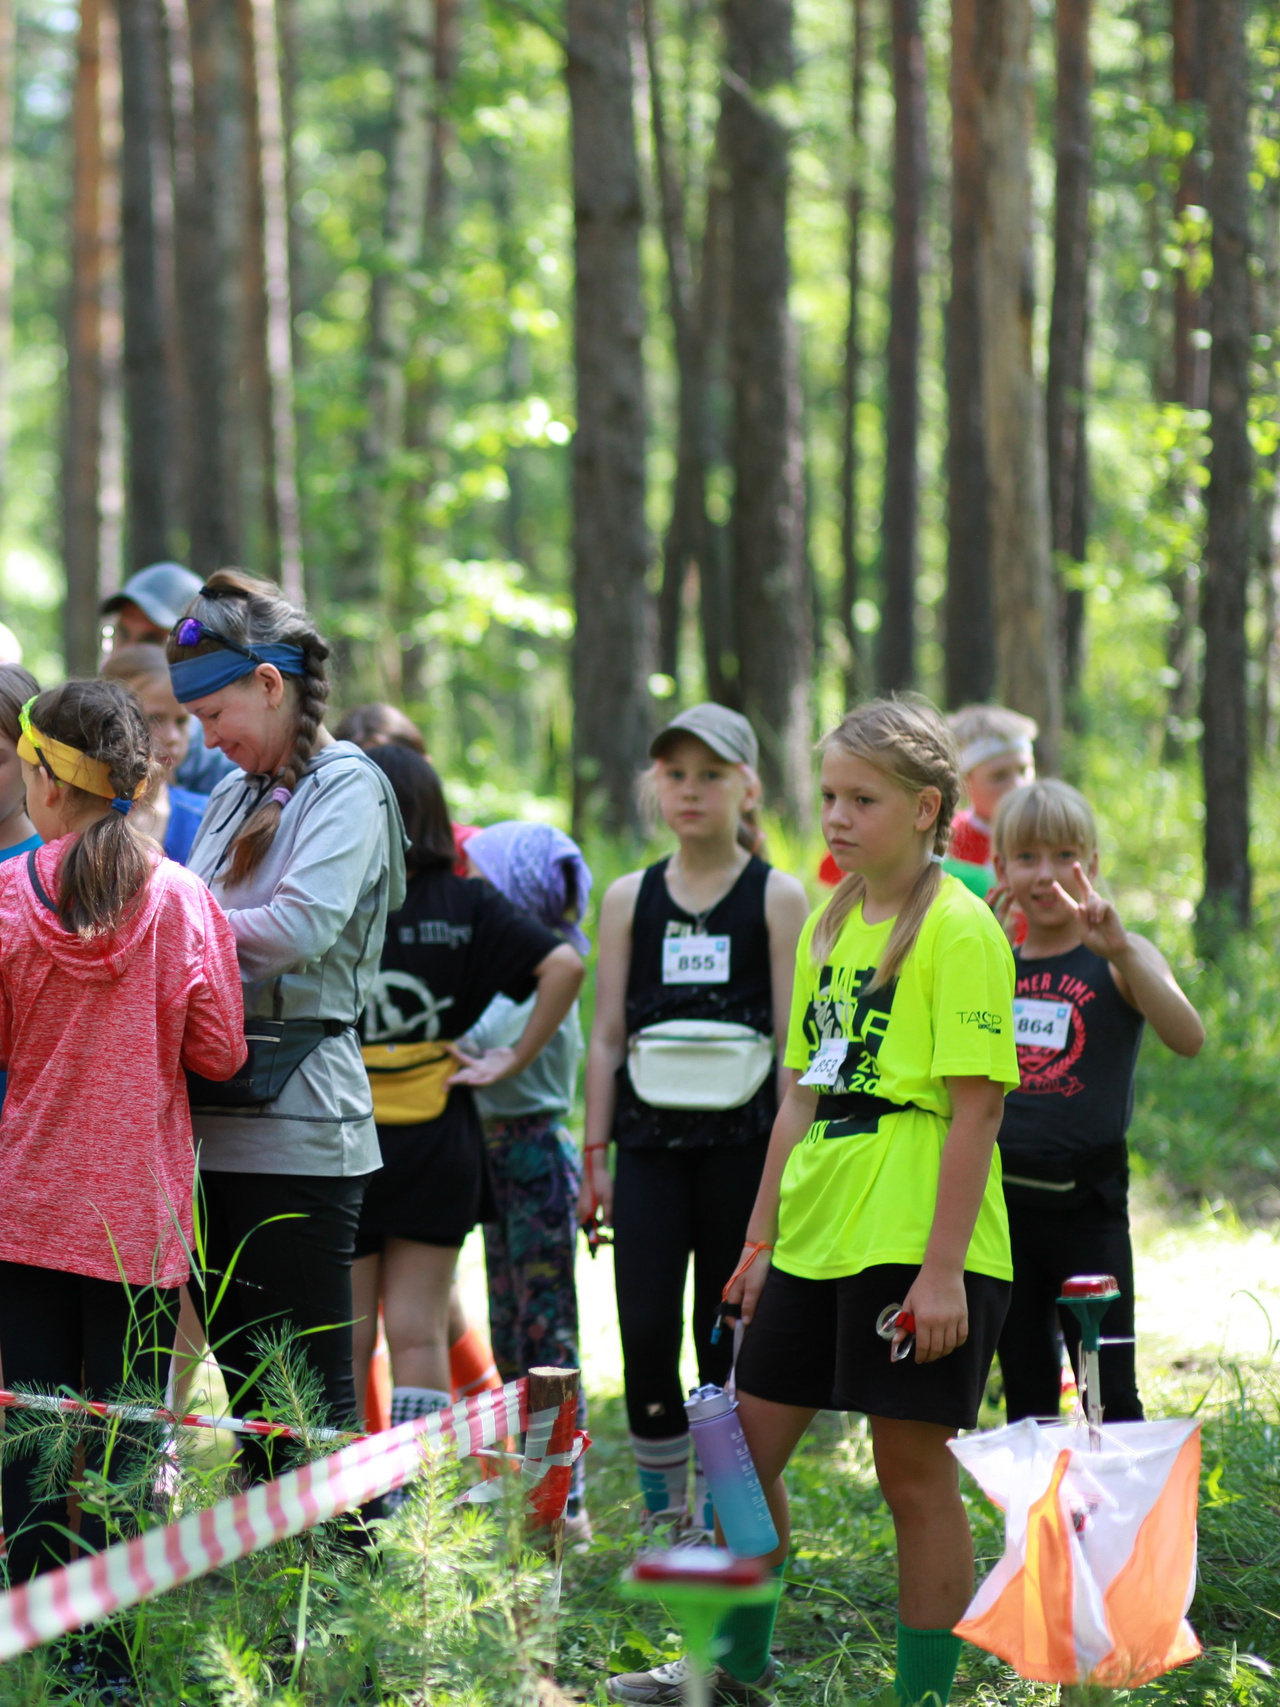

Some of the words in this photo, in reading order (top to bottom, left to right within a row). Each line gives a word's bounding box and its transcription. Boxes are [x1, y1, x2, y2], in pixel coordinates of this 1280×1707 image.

[679, 955, 715, 971] 855
[1016, 972, 1052, 995] MER
[1058, 974, 1097, 1007] TIME
[1018, 1018, 1054, 1036] 864
[814, 1058, 838, 1073] 853
